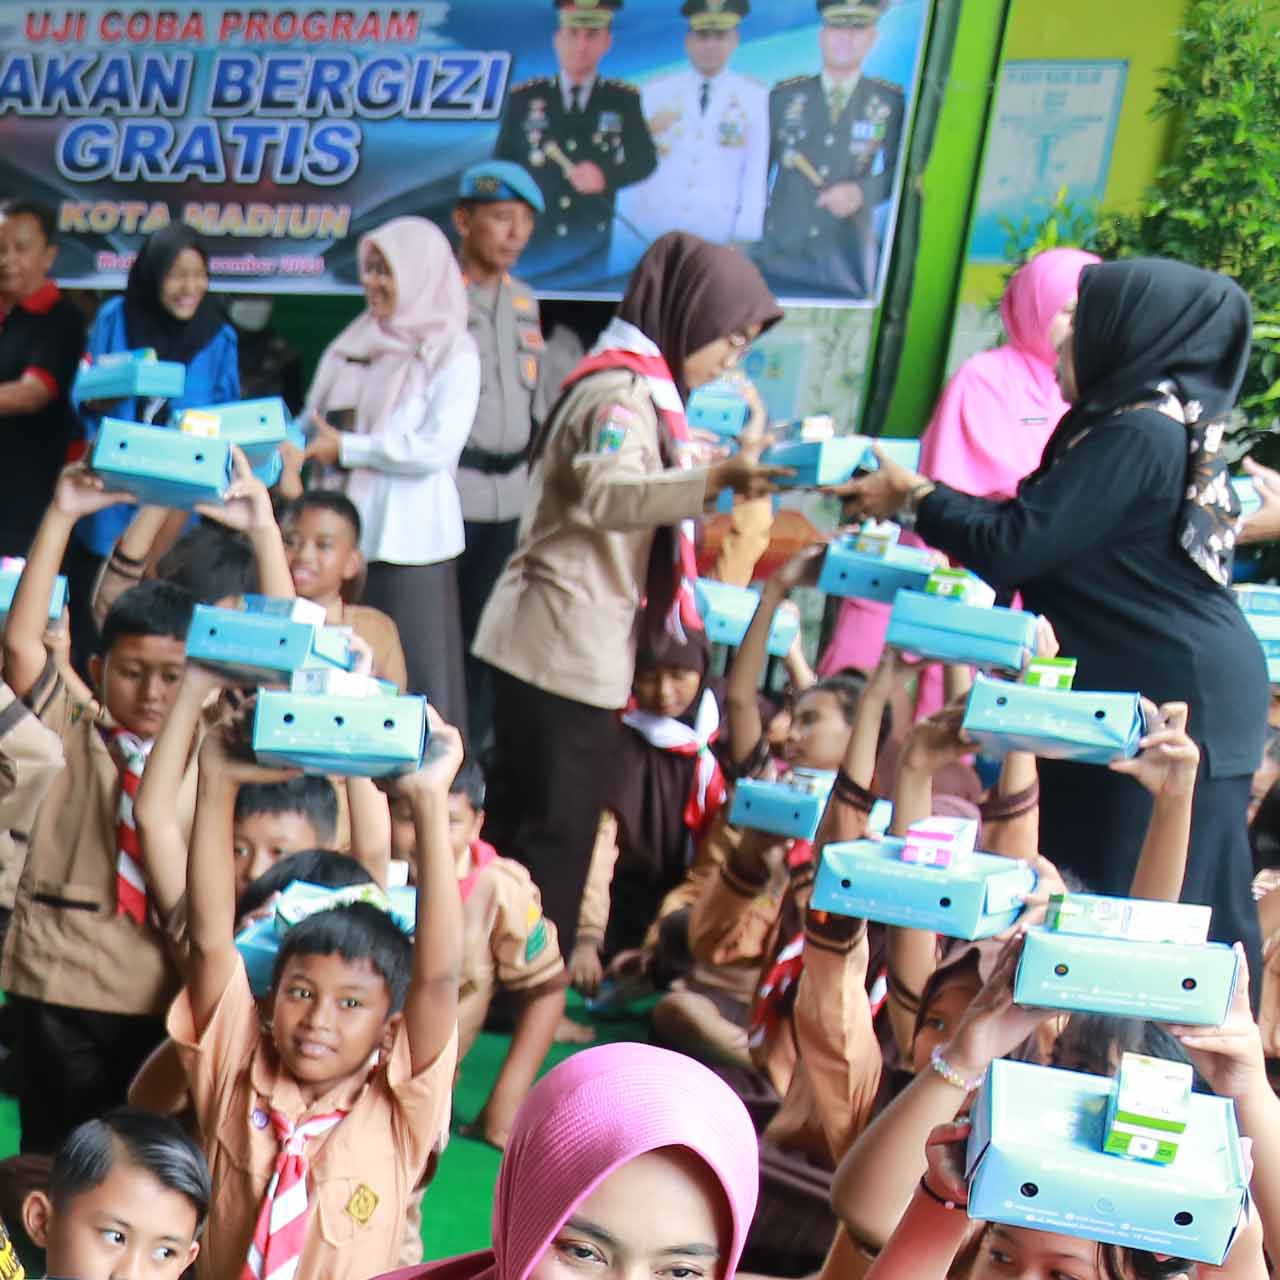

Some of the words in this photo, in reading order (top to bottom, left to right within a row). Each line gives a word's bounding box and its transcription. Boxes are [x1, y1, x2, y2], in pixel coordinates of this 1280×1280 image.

[24, 12, 86, 42] UJI
[99, 11, 205, 42] COBA
[217, 10, 420, 42] PROGRAM
[206, 51, 512, 120] BERGIZI
[56, 118, 362, 184] GRATIS
[58, 201, 171, 234] KOTA
[183, 203, 352, 239] MADIUN
